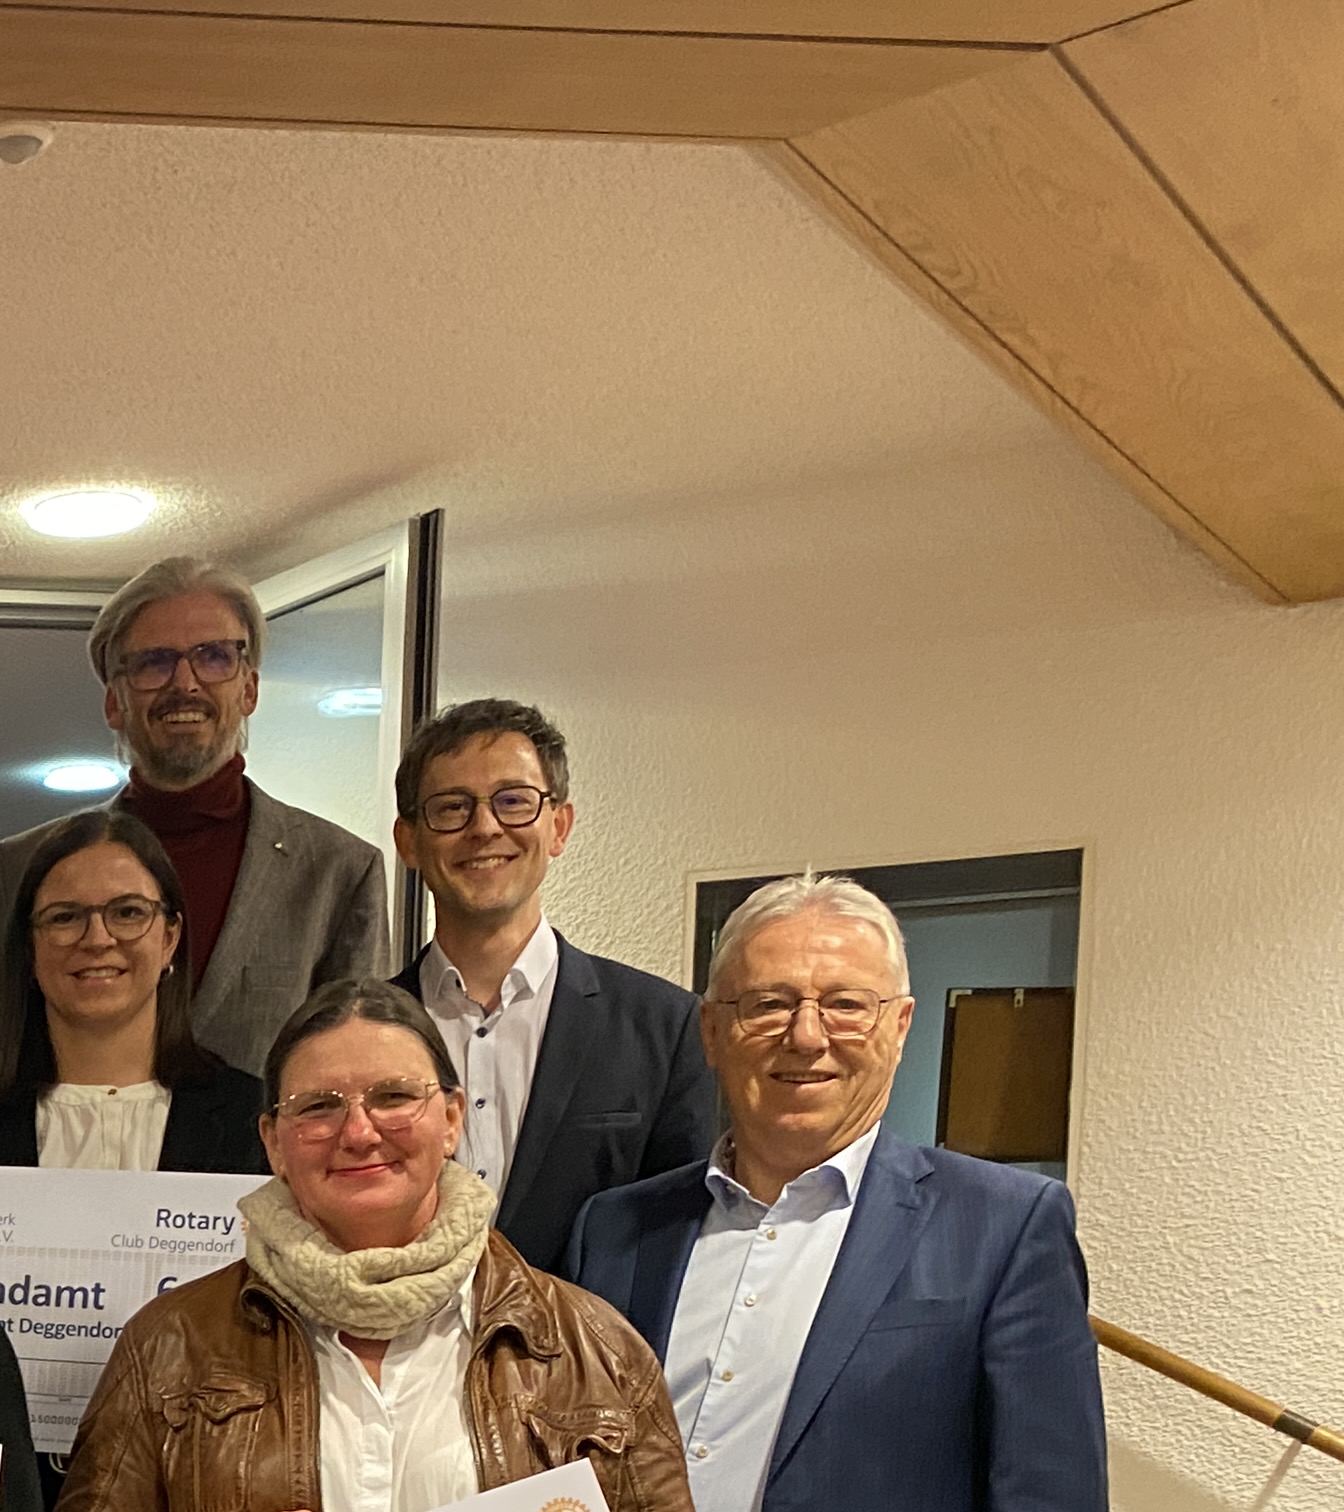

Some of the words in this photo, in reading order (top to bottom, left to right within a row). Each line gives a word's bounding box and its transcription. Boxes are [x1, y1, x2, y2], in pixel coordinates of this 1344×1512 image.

[156, 1208, 236, 1235] Rotary
[110, 1233, 144, 1249] Club
[148, 1236, 236, 1254] Deggendorf
[19, 1318, 124, 1340] Deggendor
